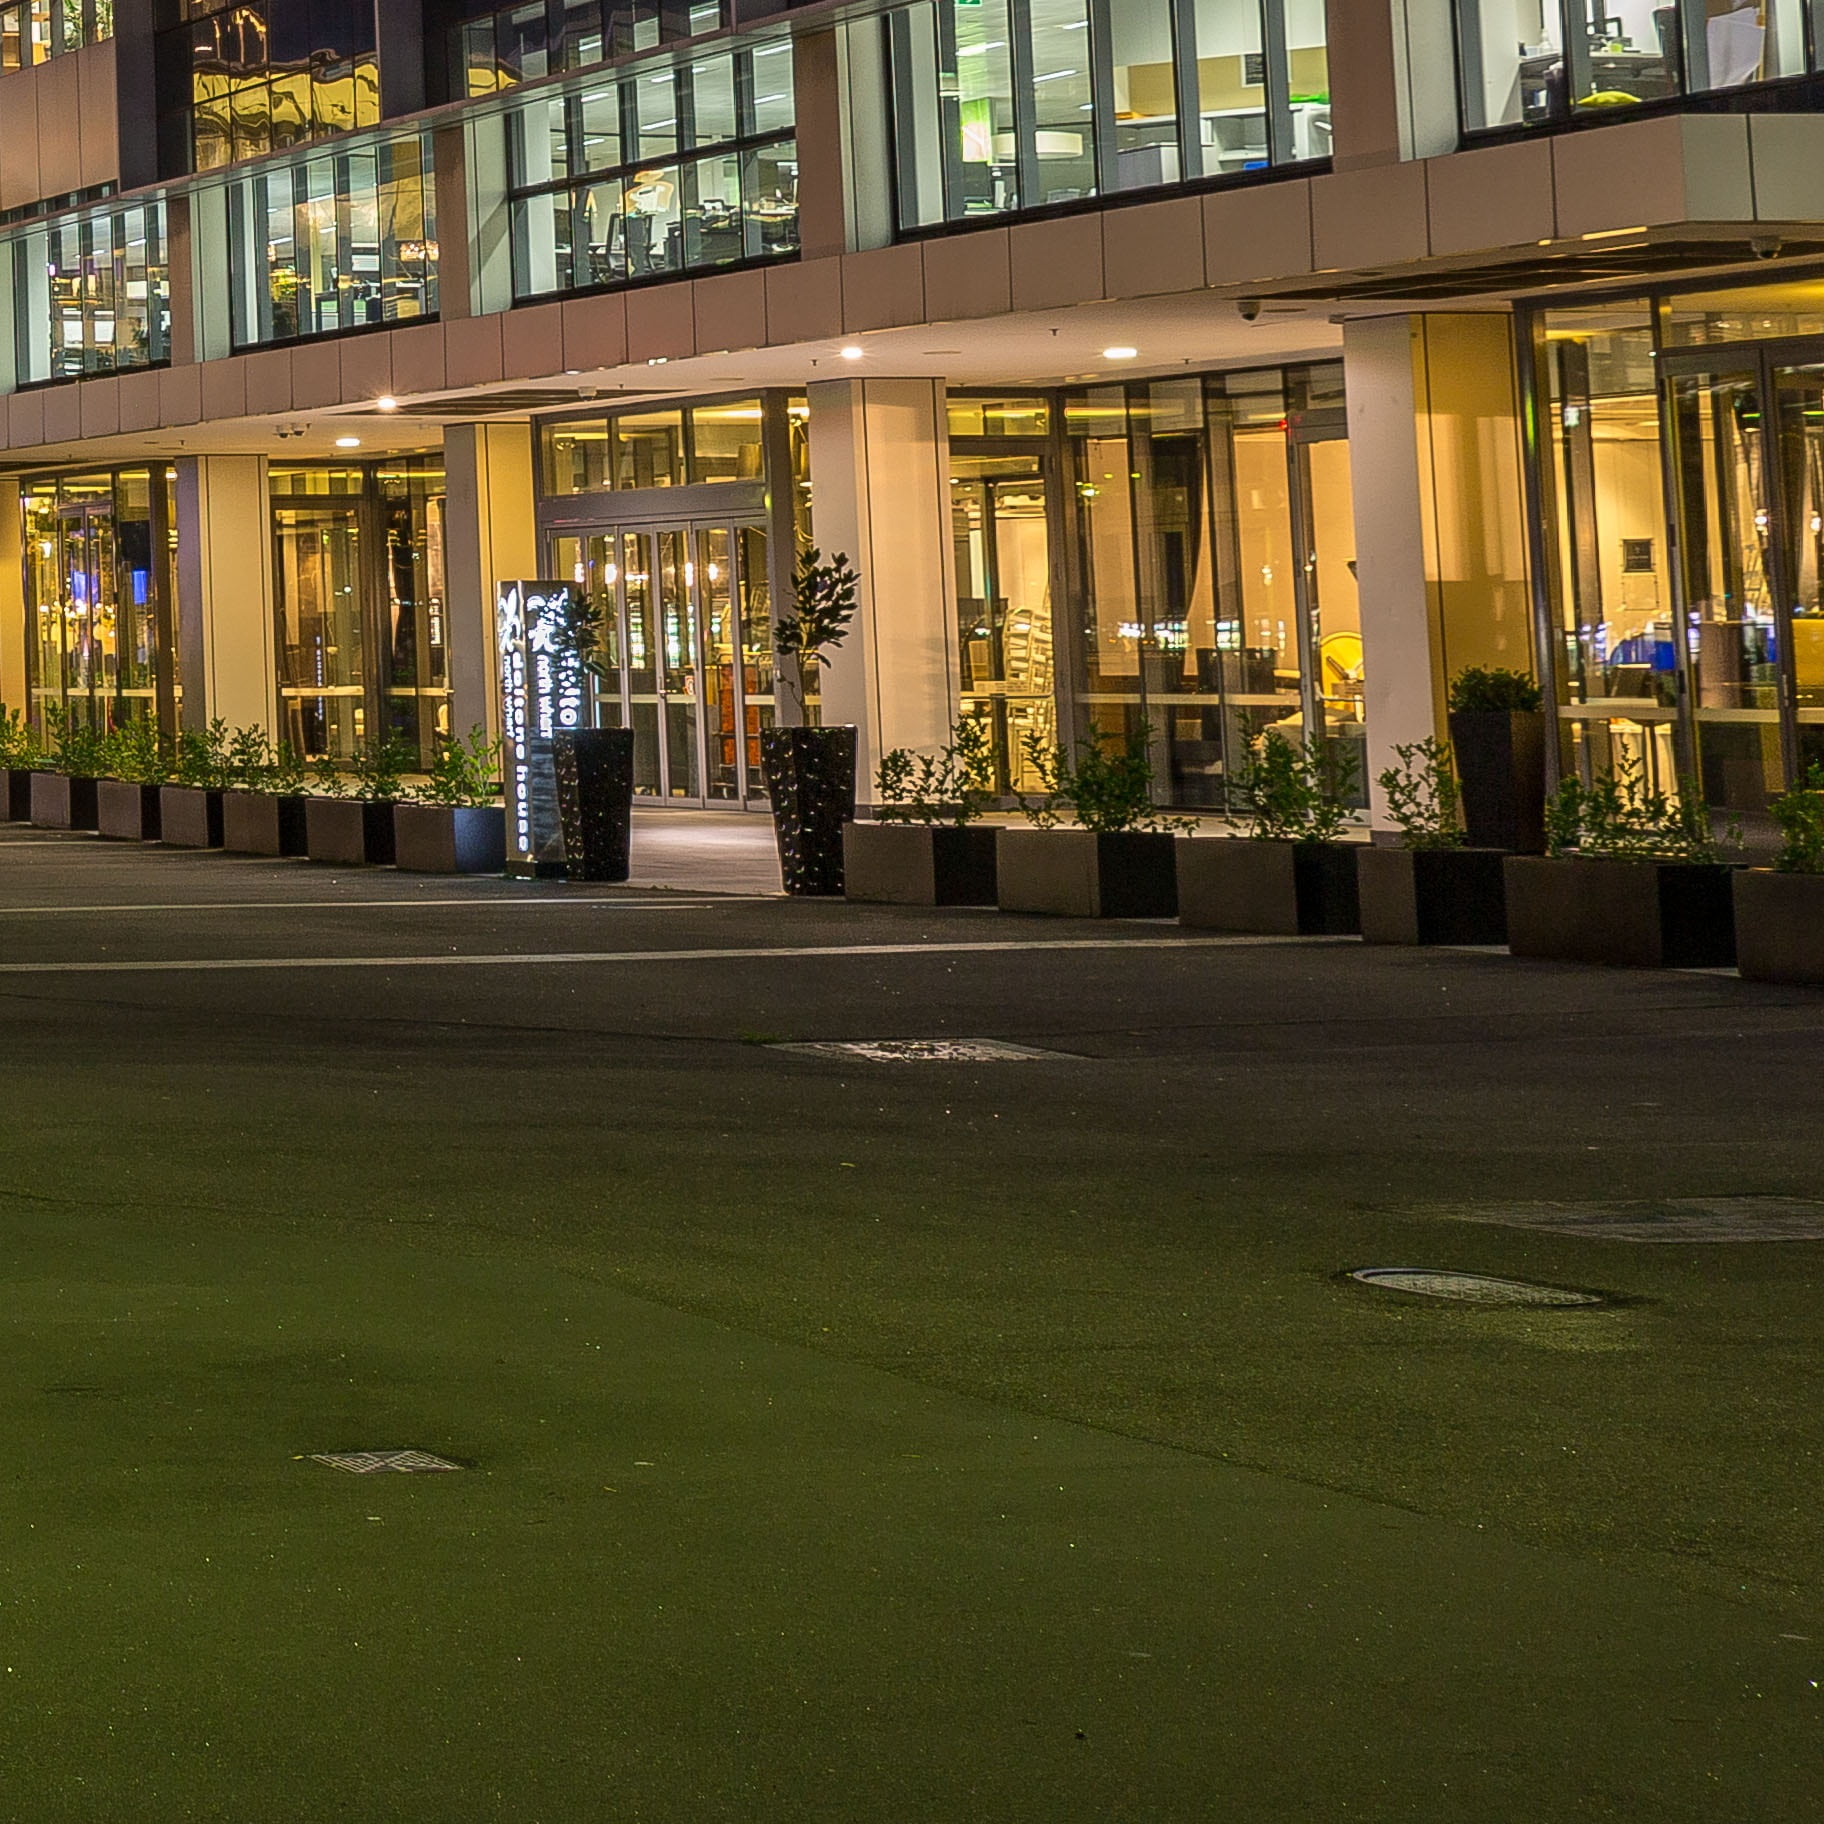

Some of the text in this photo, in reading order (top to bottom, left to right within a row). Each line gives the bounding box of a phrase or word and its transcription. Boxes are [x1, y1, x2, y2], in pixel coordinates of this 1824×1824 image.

[504, 655, 515, 738] north wharf
[537, 654, 553, 694] north
[512, 652, 529, 852] doltone house
